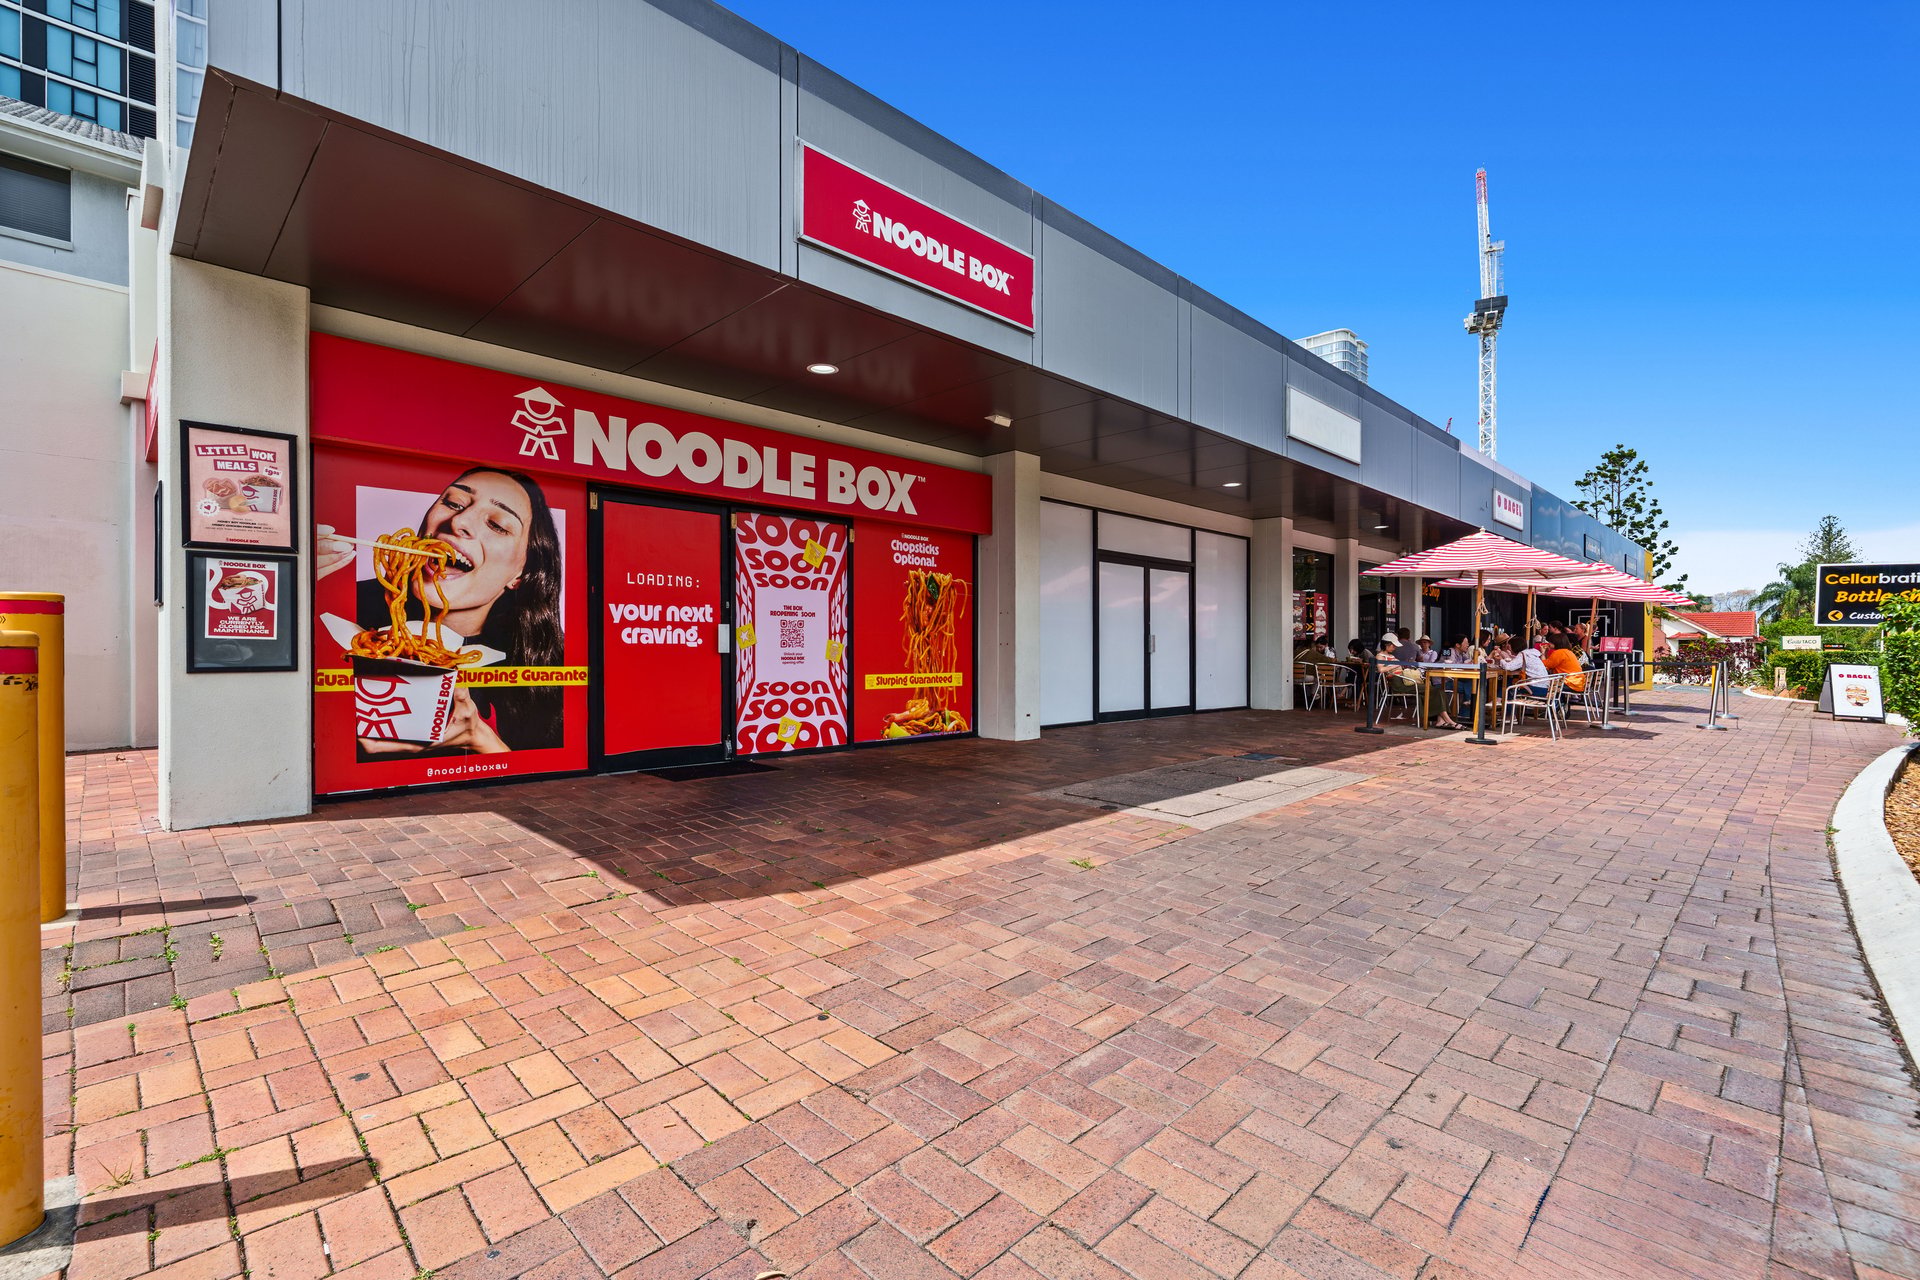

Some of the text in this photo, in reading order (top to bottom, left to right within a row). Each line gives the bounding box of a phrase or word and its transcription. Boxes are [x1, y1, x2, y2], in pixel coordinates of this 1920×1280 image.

[873, 211, 966, 276] NOODLE
[198, 446, 274, 462] LITTLE WOK
[573, 408, 816, 500] NOODLE
[216, 461, 256, 471] MEALS
[1504, 498, 1522, 517] BAGEL
[891, 539, 939, 555] Chopsticks
[745, 548, 836, 575] soon
[893, 553, 937, 567] Optional.
[627, 572, 700, 588] LOADING:
[754, 572, 829, 591] soon
[1834, 588, 1893, 603] Bottle
[608, 604, 713, 623] your next
[621, 625, 703, 647] craving.
[456, 669, 587, 684] Slurping Guarante
[876, 675, 952, 686] Slurping Guaranteed
[753, 680, 830, 697] soon
[430, 673, 454, 741] NOODLE BOX
[743, 697, 838, 721] soon
[736, 720, 847, 755] soon
[427, 763, 508, 776] @noodleboxau
